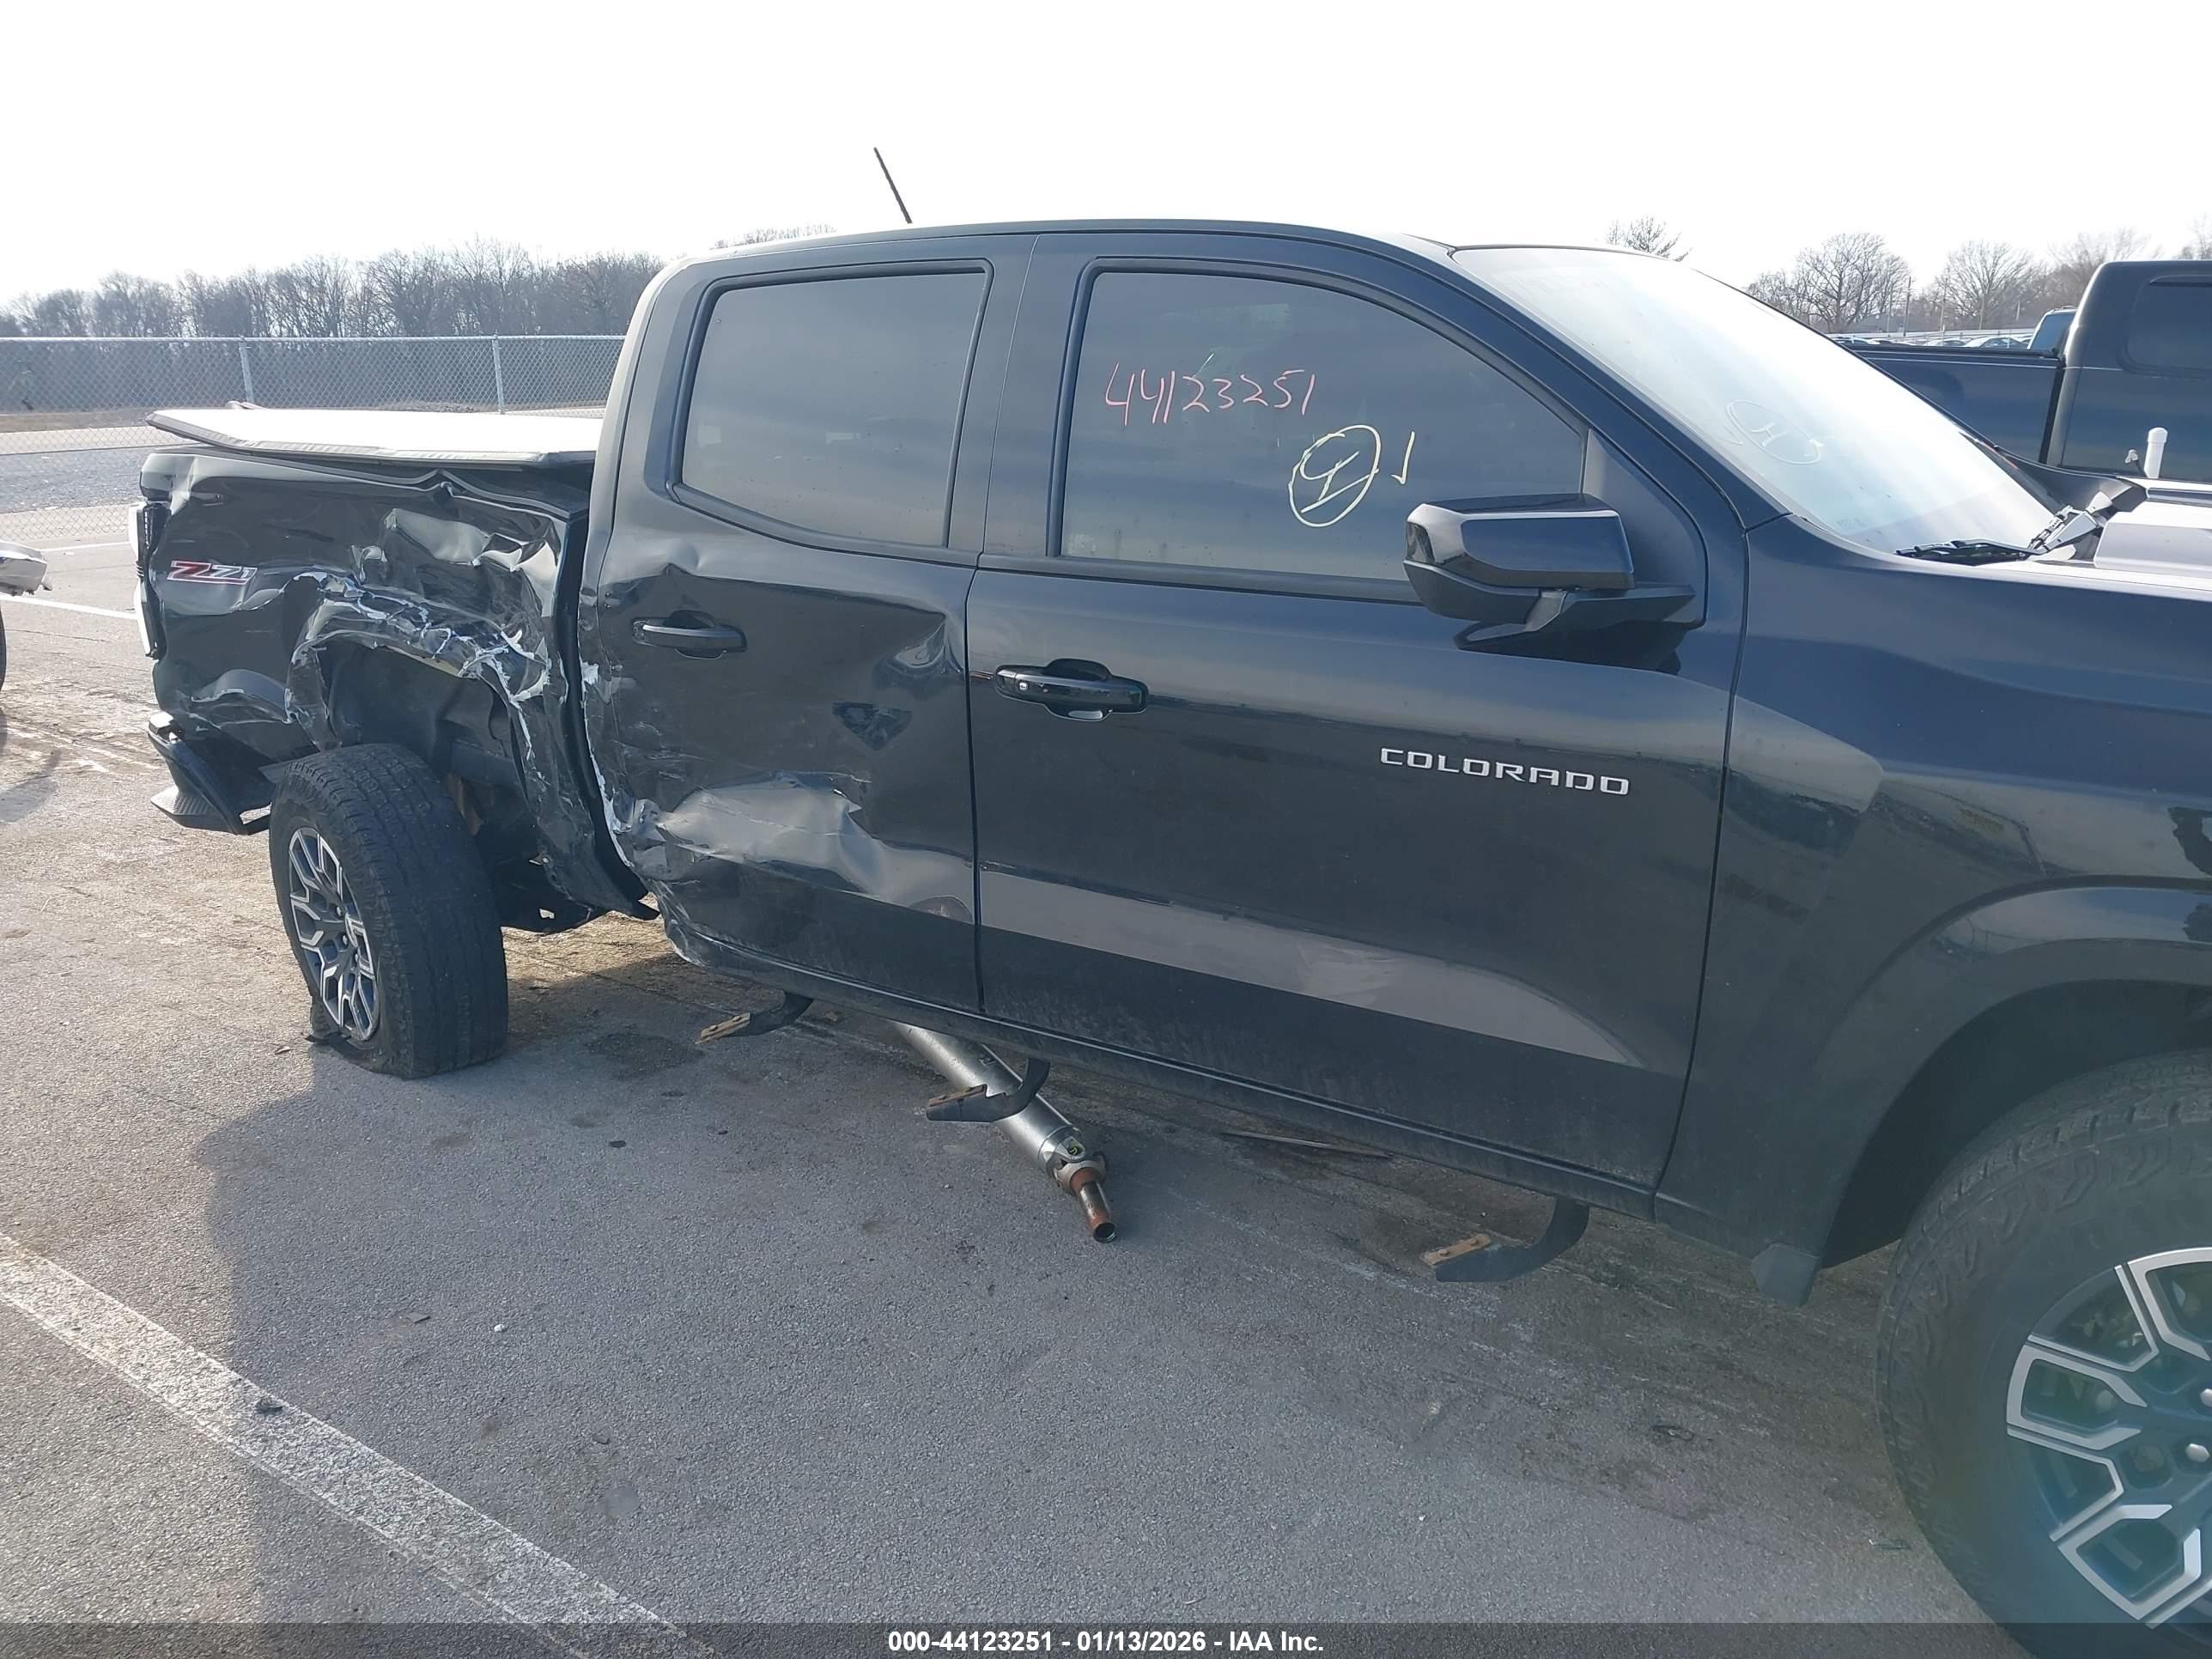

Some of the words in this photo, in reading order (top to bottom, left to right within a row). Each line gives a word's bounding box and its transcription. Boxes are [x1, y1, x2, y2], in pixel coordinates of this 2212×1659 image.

[1105, 362, 1316, 426] 44123251
[167, 560, 258, 585] Z71
[1380, 747, 1630, 795] COLORADO
